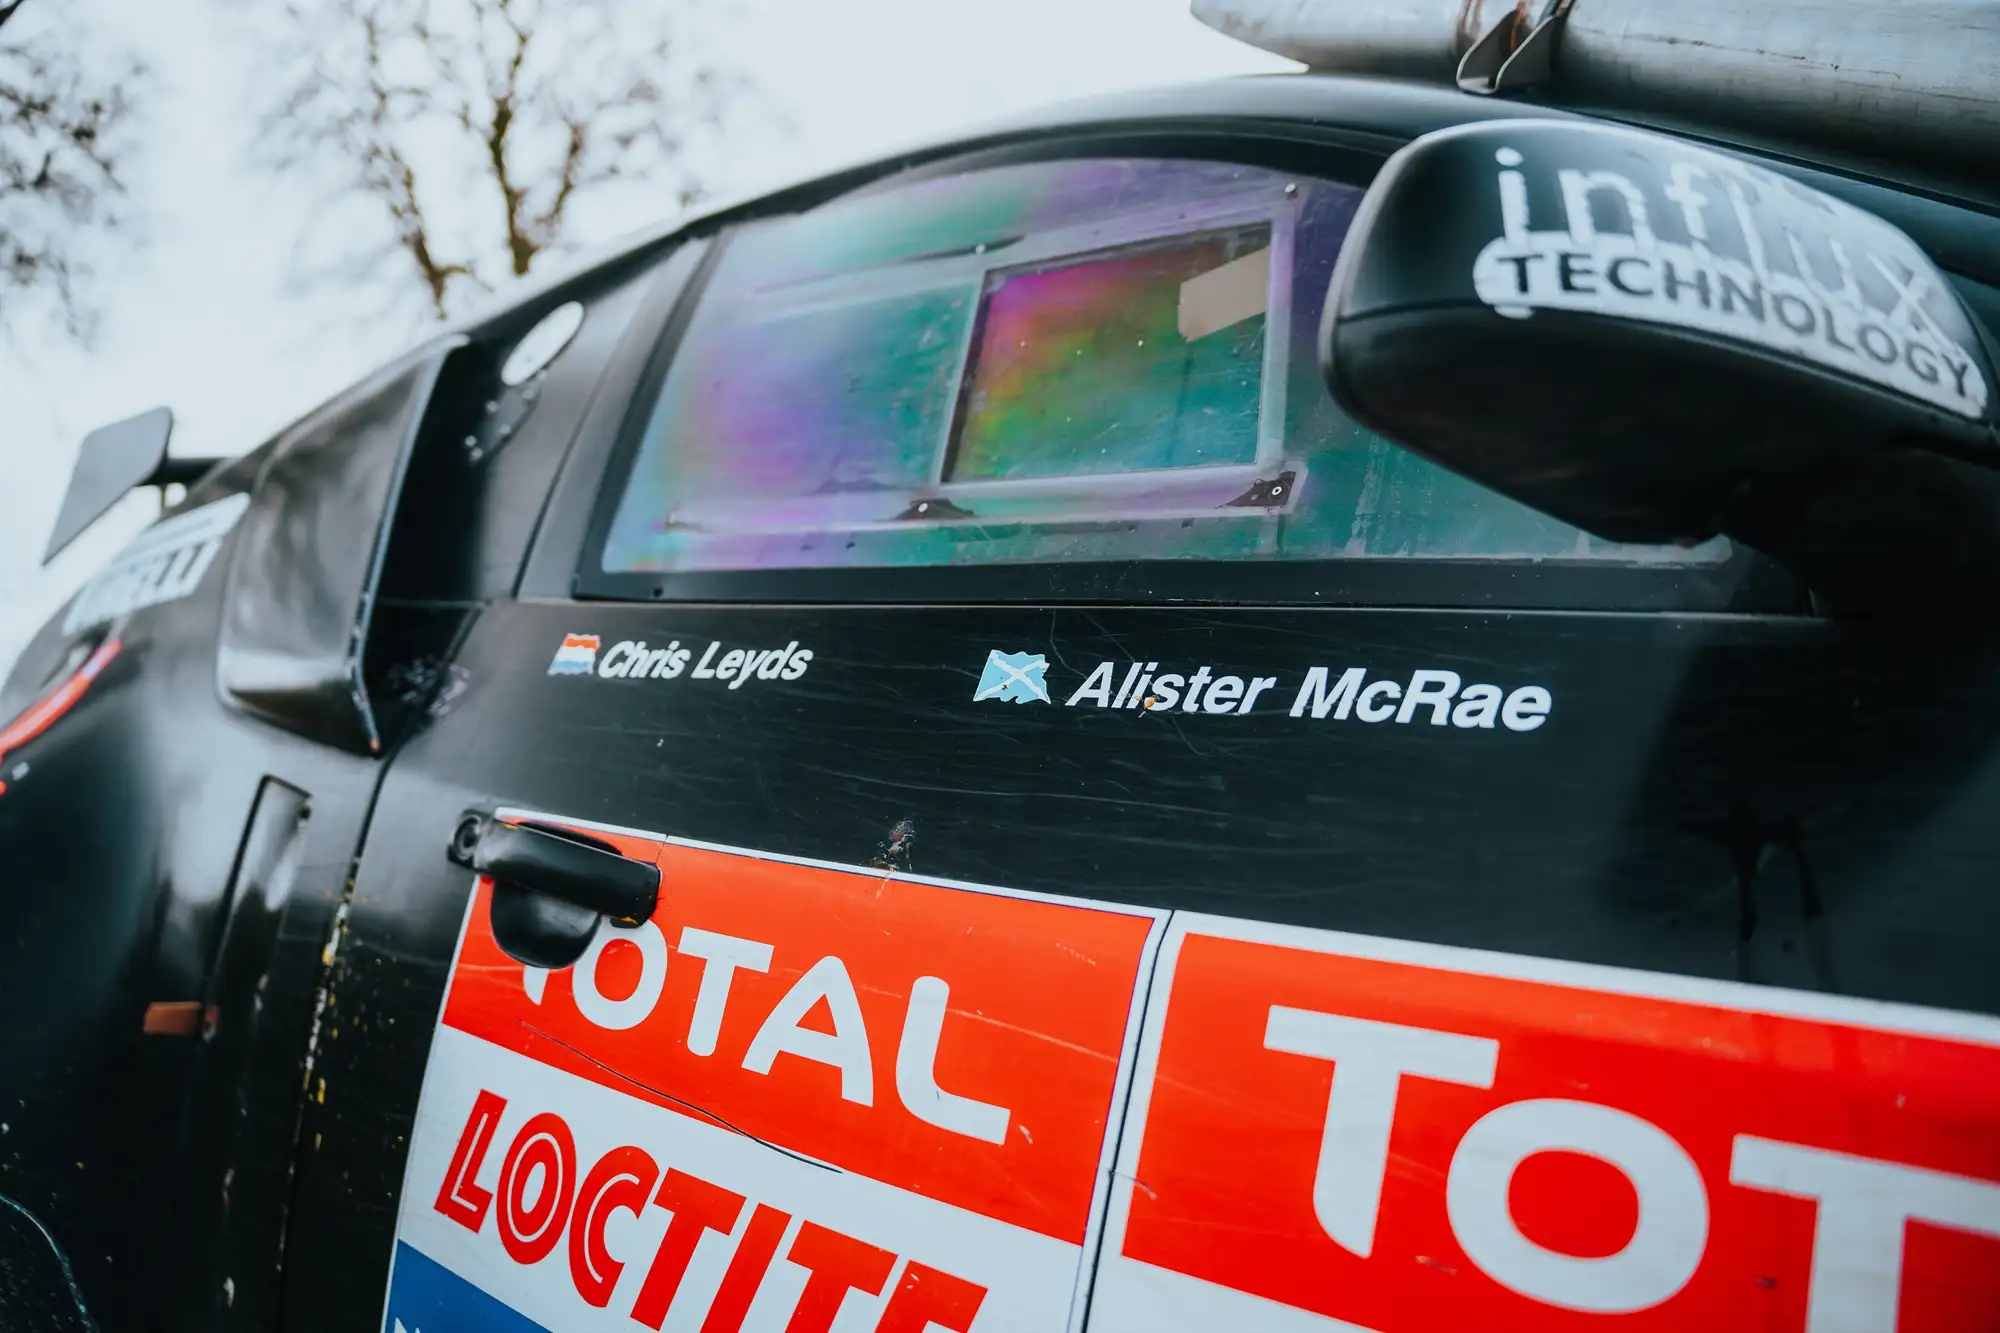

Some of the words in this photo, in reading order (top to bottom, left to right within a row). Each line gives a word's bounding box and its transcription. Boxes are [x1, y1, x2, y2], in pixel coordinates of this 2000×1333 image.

[1496, 251, 1970, 398] TECHNOLOGY
[598, 640, 691, 679] Chris
[691, 640, 814, 690] Leyds
[1065, 661, 1276, 715] Alister
[1289, 667, 1552, 731] McRae
[522, 913, 1012, 1146] OTAL
